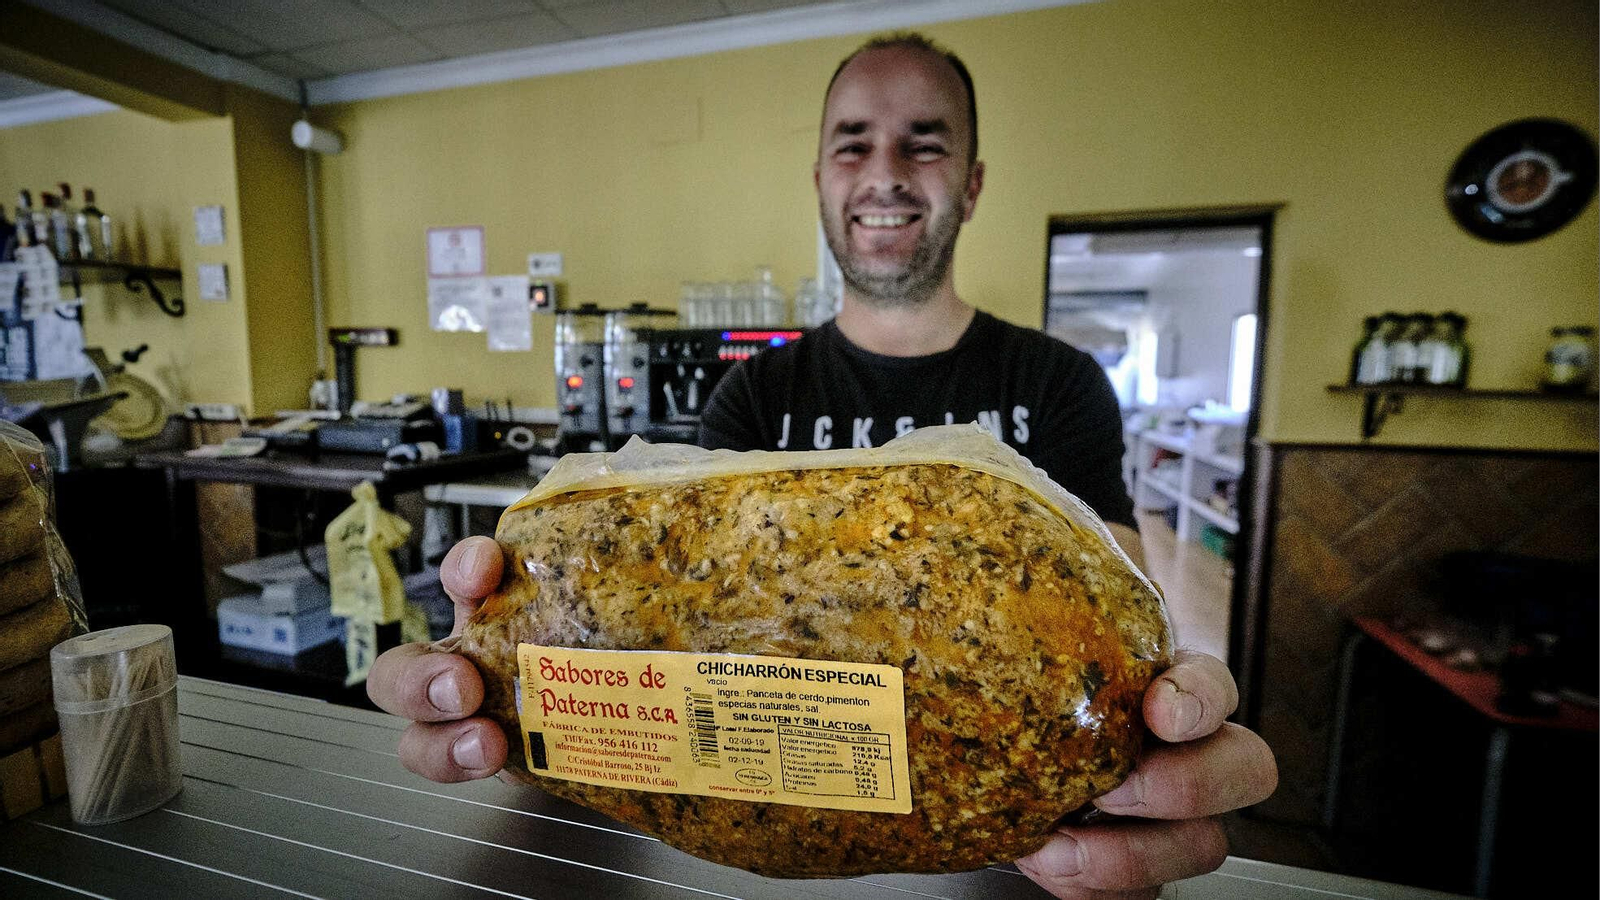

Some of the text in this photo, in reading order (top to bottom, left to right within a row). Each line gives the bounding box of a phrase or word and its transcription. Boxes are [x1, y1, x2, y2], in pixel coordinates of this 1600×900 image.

[539, 656, 666, 689] Sabores de
[697, 661, 887, 688] CHICHARRÓN ESPECIAL
[746, 689, 783, 699] Panceta
[785, 691, 796, 700] de
[537, 688, 631, 719] Paterna
[718, 700, 757, 709] especias
[732, 712, 749, 721] SIN
[751, 714, 791, 724] GLUTEN
[803, 717, 819, 727] SIN
[821, 720, 872, 732] LACTOSA
[591, 727, 606, 735] DE
[609, 728, 678, 742] EMBUTIDOS
[597, 737, 616, 748] 956
[619, 739, 638, 750] 416
[641, 741, 658, 753] 112
[634, 762, 643, 770] 25
[574, 767, 608, 780] PATERNA
[608, 772, 620, 780] DE
[621, 773, 651, 785] RIVERA
